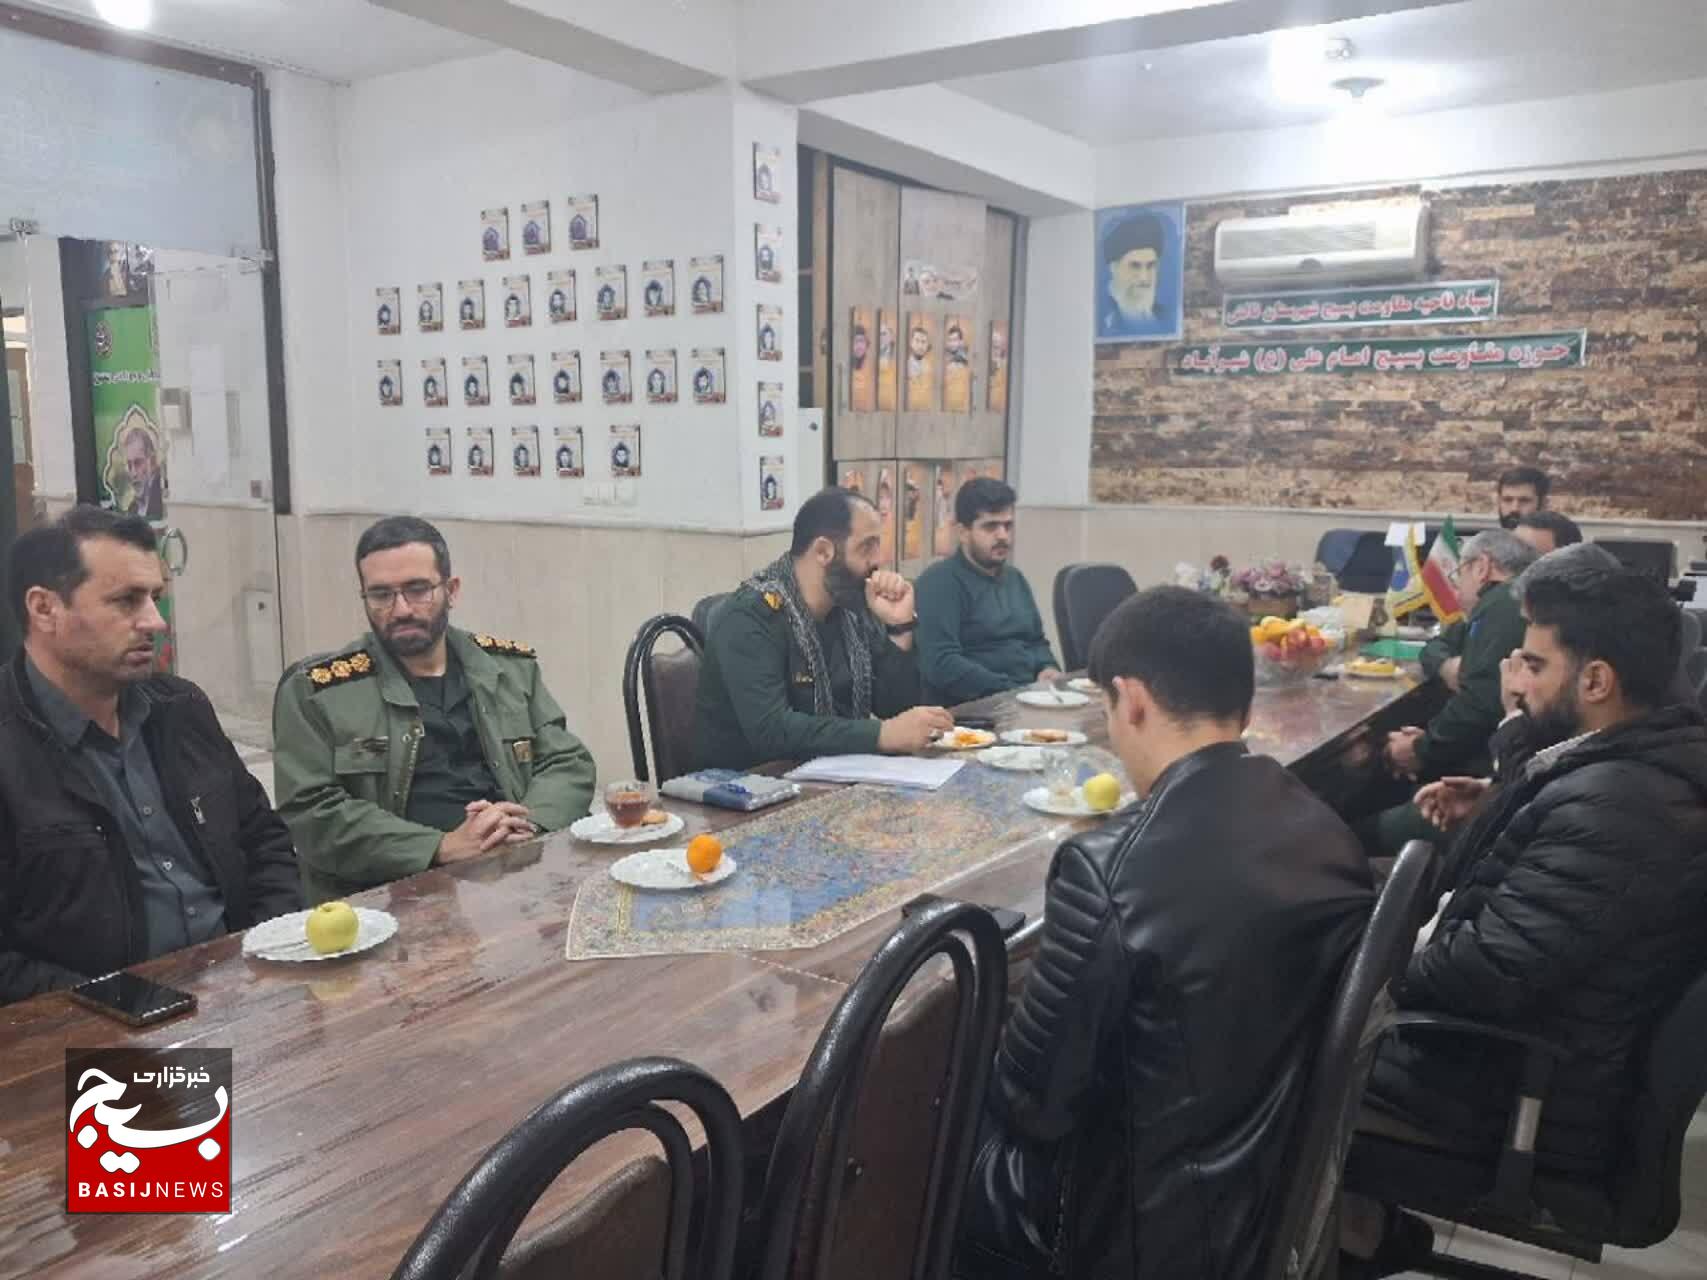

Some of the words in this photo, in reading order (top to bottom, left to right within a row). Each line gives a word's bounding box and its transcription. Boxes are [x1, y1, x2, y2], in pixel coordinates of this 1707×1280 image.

[1262, 300, 1319, 322] شهرستان
[1320, 300, 1357, 320] بسیج
[1358, 294, 1412, 318] مقاومت
[1414, 290, 1456, 316] ناحیه
[1289, 346, 1323, 372] علی
[1326, 344, 1371, 371] امام
[1374, 348, 1425, 369] بسیج
[1428, 341, 1505, 370] مقاومت
[1508, 344, 1570, 368] حوزه
